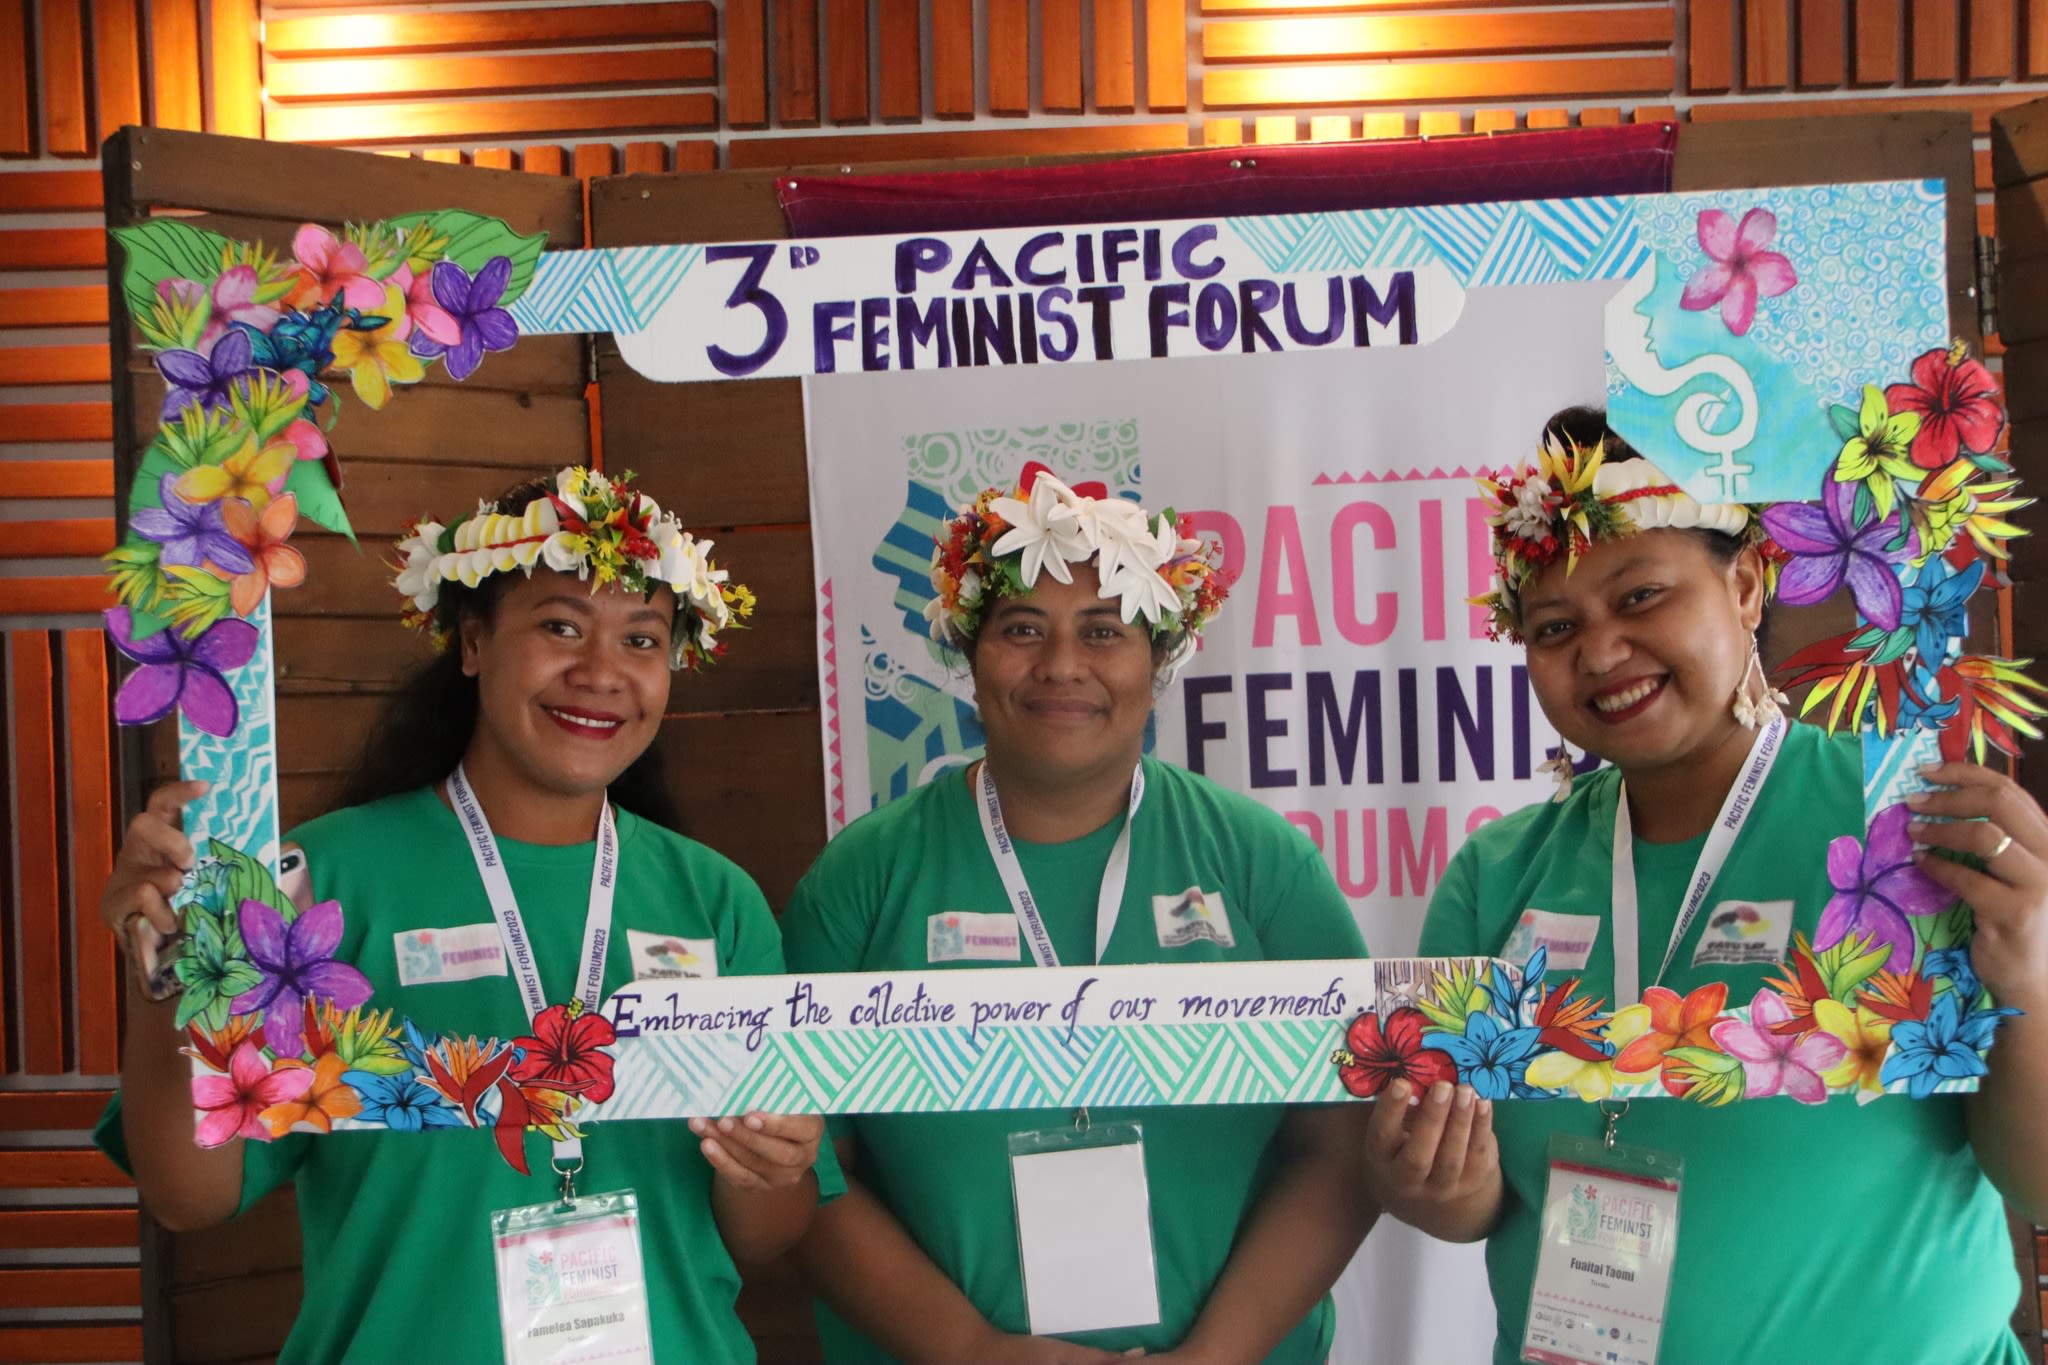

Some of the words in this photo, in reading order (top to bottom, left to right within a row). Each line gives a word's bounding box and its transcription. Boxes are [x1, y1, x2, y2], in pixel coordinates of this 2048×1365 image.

[895, 225, 1225, 294] PACIFIC
[813, 286, 1126, 373] FEMINIST
[1148, 272, 1417, 357] FORUM
[1182, 664, 1603, 790] FEMINI
[1724, 793, 1750, 830] PACIFIC
[1741, 757, 1768, 795] FEMINIST
[463, 803, 485, 835] FEMINIST
[477, 834, 497, 867] PACIFIC
[600, 857, 613, 888] PACIFIC
[1018, 890, 1045, 941] FORUM2023
[1679, 871, 1711, 935] FORUM2023
[442, 947, 500, 966] FEMINIST
[503, 910, 531, 970] FORUM2023
[965, 935, 1016, 947] FEMINIST
[1038, 942, 1056, 967] MINIST
[588, 928, 606, 987] FORUM2023
[523, 973, 543, 1014] EMINIST
[611, 993, 773, 1051] Embracing
[786, 981, 832, 1027] the
[850, 981, 955, 1028] collective
[966, 1001, 1052, 1045] power
[1060, 978, 1099, 1047] of
[1109, 997, 1157, 1021] our
[1602, 1194, 1654, 1222] PACIFIC
[1600, 1214, 1653, 1238] FEMINIST
[560, 1246, 616, 1270] PACIFIC
[561, 1264, 618, 1286] FEMINIST
[573, 1312, 624, 1330] Sapakuka
